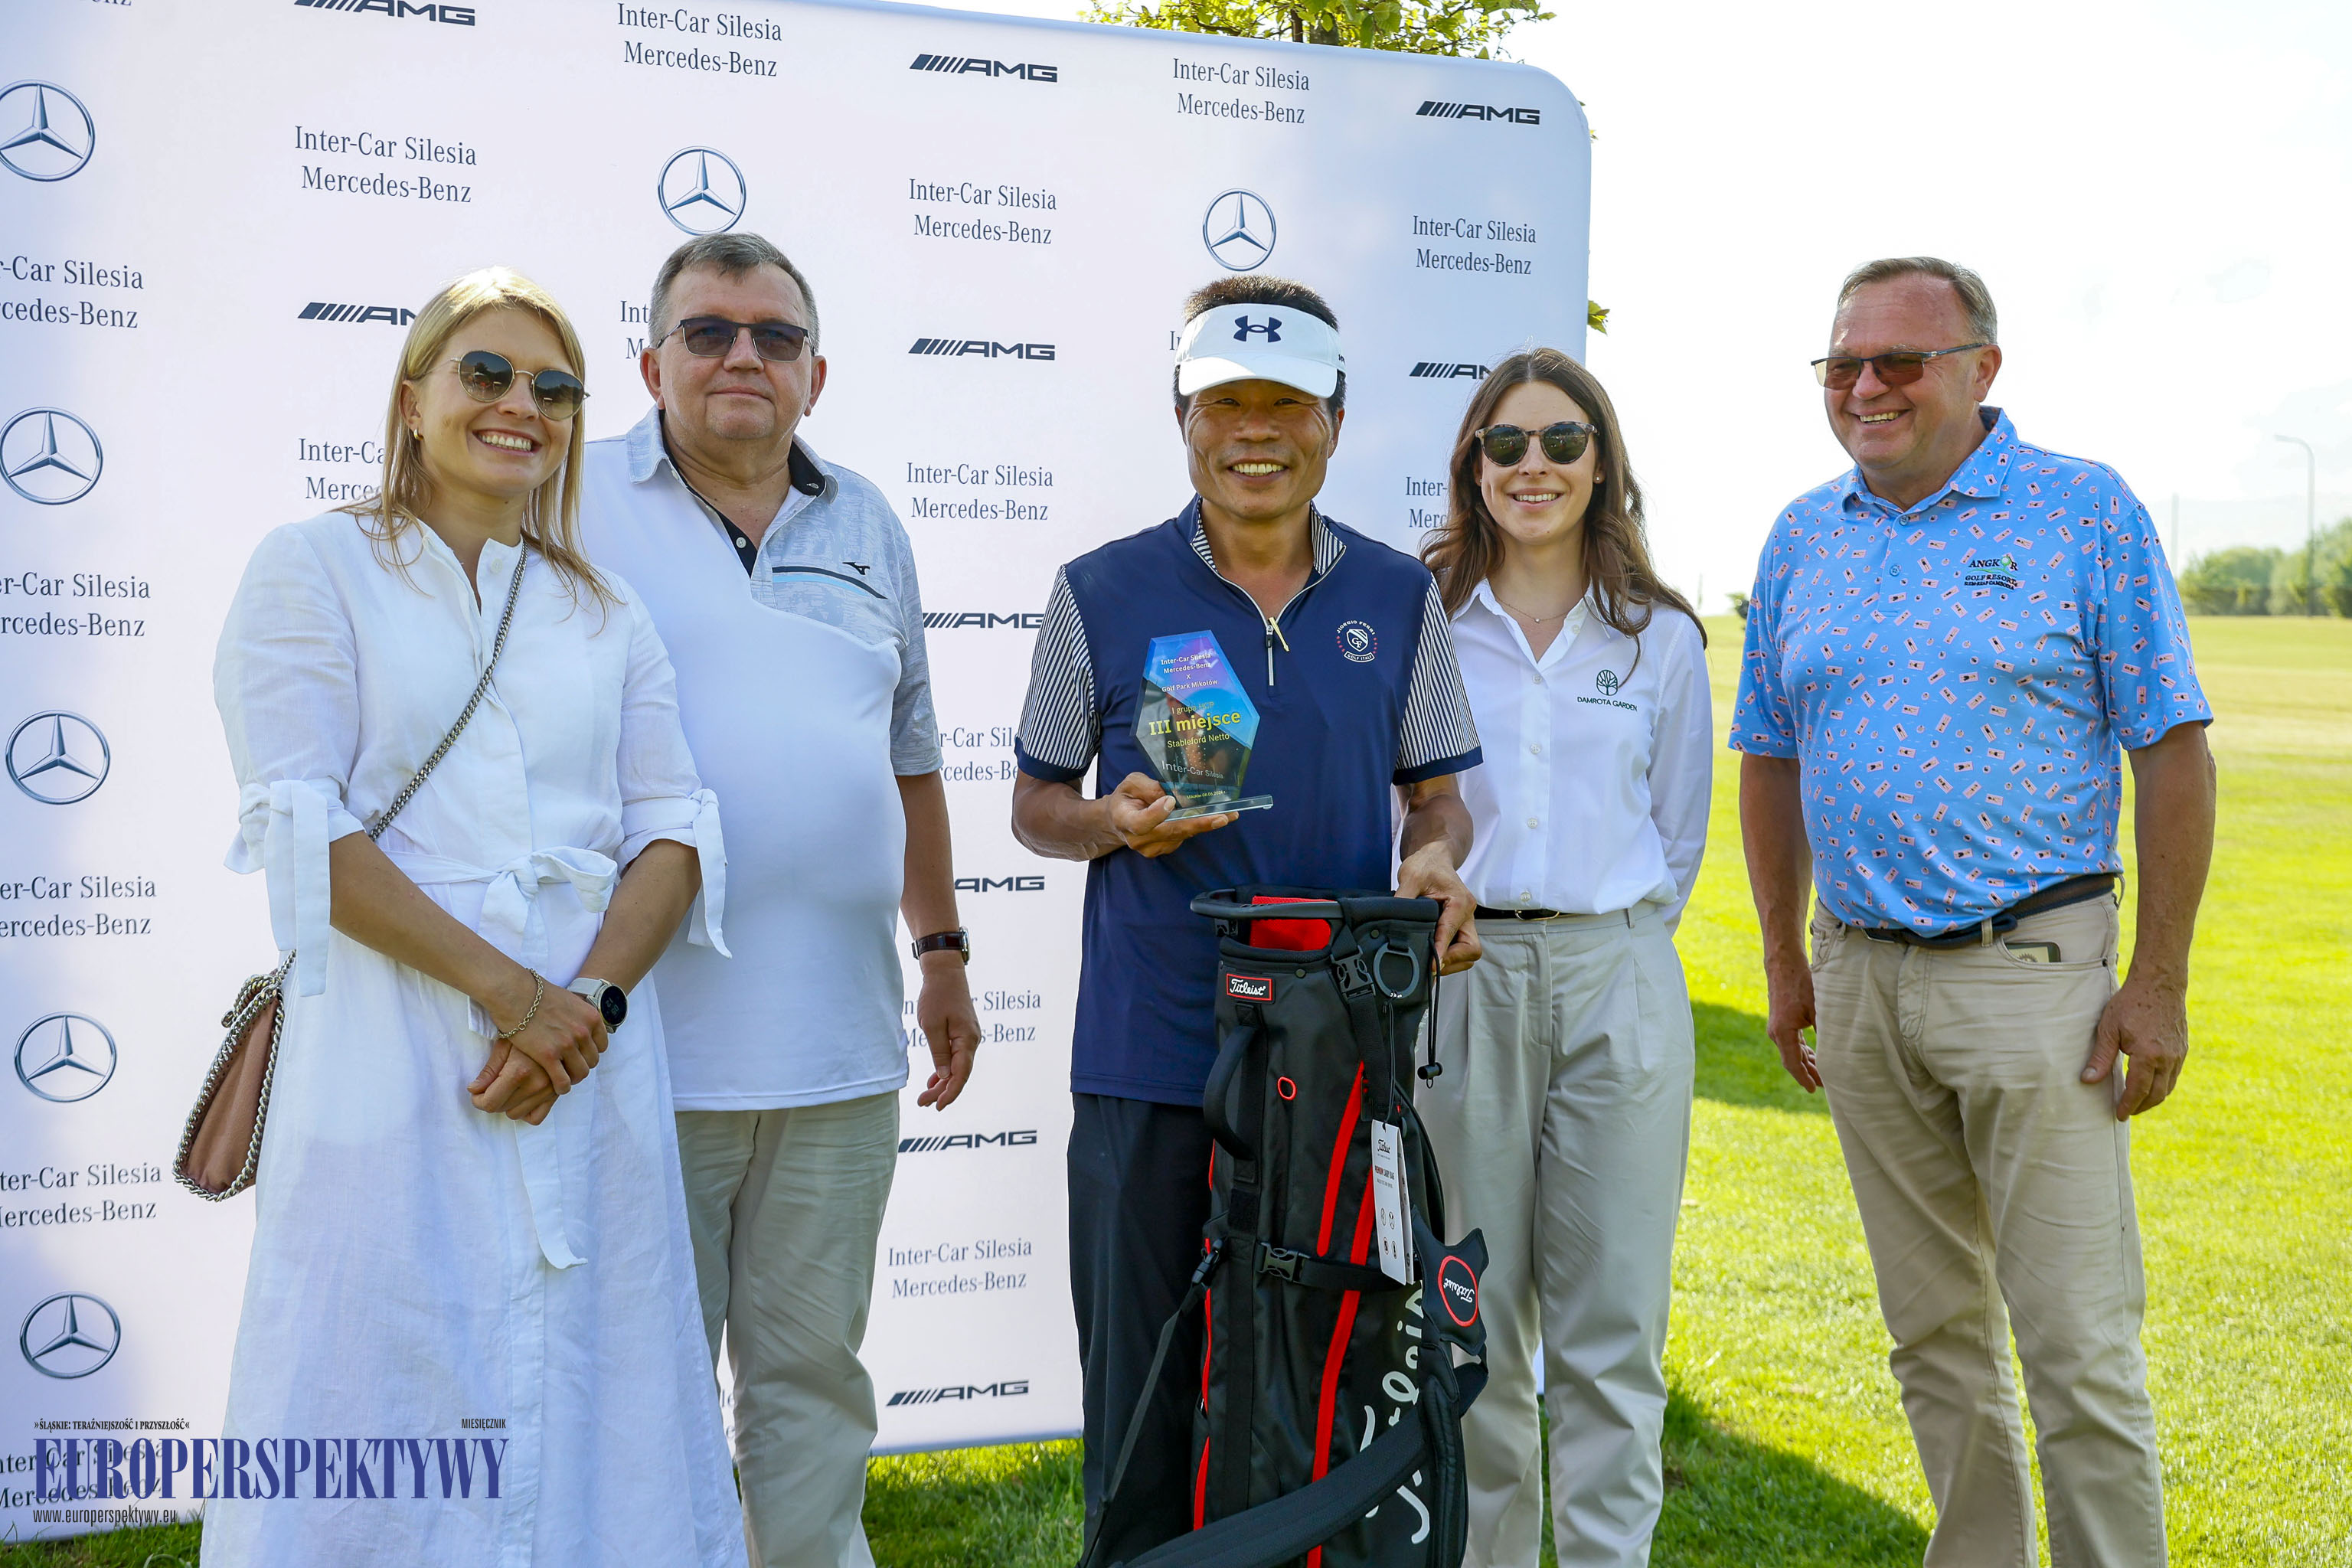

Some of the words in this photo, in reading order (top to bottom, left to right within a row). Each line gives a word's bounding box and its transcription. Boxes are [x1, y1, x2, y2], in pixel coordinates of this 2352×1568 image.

[618, 3, 709, 34] Inter-Car
[717, 14, 782, 41] Silesia
[624, 41, 777, 77] Mercedes-Benz
[1173, 58, 1250, 85] Inter-Car
[1256, 67, 1309, 91] Silesia
[1177, 93, 1305, 124] Mercedes-Benz
[295, 126, 397, 158] Inter-Car
[405, 137, 476, 165] Silesia
[302, 165, 472, 202] Mercedes-Benz
[909, 178, 991, 205] Inter-Car
[998, 185, 1056, 210] Silesia
[913, 214, 1051, 244] Mercedes-Benz
[1413, 216, 1481, 239] Inter-Car
[1487, 220, 1536, 243] Silesia
[64, 260, 143, 289] Silesia
[1416, 249, 1531, 275] Mercedes-Benz
[0, 299, 137, 328] cedes-Benz
[299, 438, 384, 463] Inter-Ca
[906, 462, 988, 485] Inter-Car
[995, 464, 1053, 487] Silesia
[1406, 476, 1448, 496] Inter-
[911, 497, 1048, 521] Mercedes-Benz
[0, 572, 64, 596] r-Car
[73, 573, 151, 598] Silesia
[1, 612, 145, 636] rcedes-Benz
[1161, 655, 1189, 665] Inter-Car
[1191, 653, 1211, 662] Silesia
[1164, 663, 1211, 674] Mercedes-Benz
[1176, 682, 1190, 691] Park
[1176, 704, 1196, 715] grupa
[1577, 697, 1612, 705] DAMROTA
[1612, 701, 1638, 710] GARDEN
[1149, 719, 1171, 735] III
[1177, 712, 1241, 732] miejsce
[940, 727, 984, 747] r-Car
[1168, 736, 1207, 748] Stableford
[1209, 733, 1230, 743] Netto
[1162, 760, 1204, 776] Inter-Car
[1205, 769, 1223, 779] Silesia
[0, 876, 72, 900] er-Car
[80, 876, 156, 898] Silesia
[955, 876, 1044, 892] AMG
[0, 913, 151, 937] ercedes-Benz
[1230, 978, 1266, 995] Titleist
[984, 990, 1041, 1011] Silesia
[0, 1167, 79, 1191] ter-Car
[87, 1162, 161, 1187] Silesia
[0, 1200, 156, 1227] ercedes-Benz
[889, 1243, 969, 1266] Inter-Car
[975, 1237, 1031, 1259] Silesia
[893, 1271, 1027, 1298] Mercedes-Benz
[1443, 1278, 1475, 1302] Titleist
